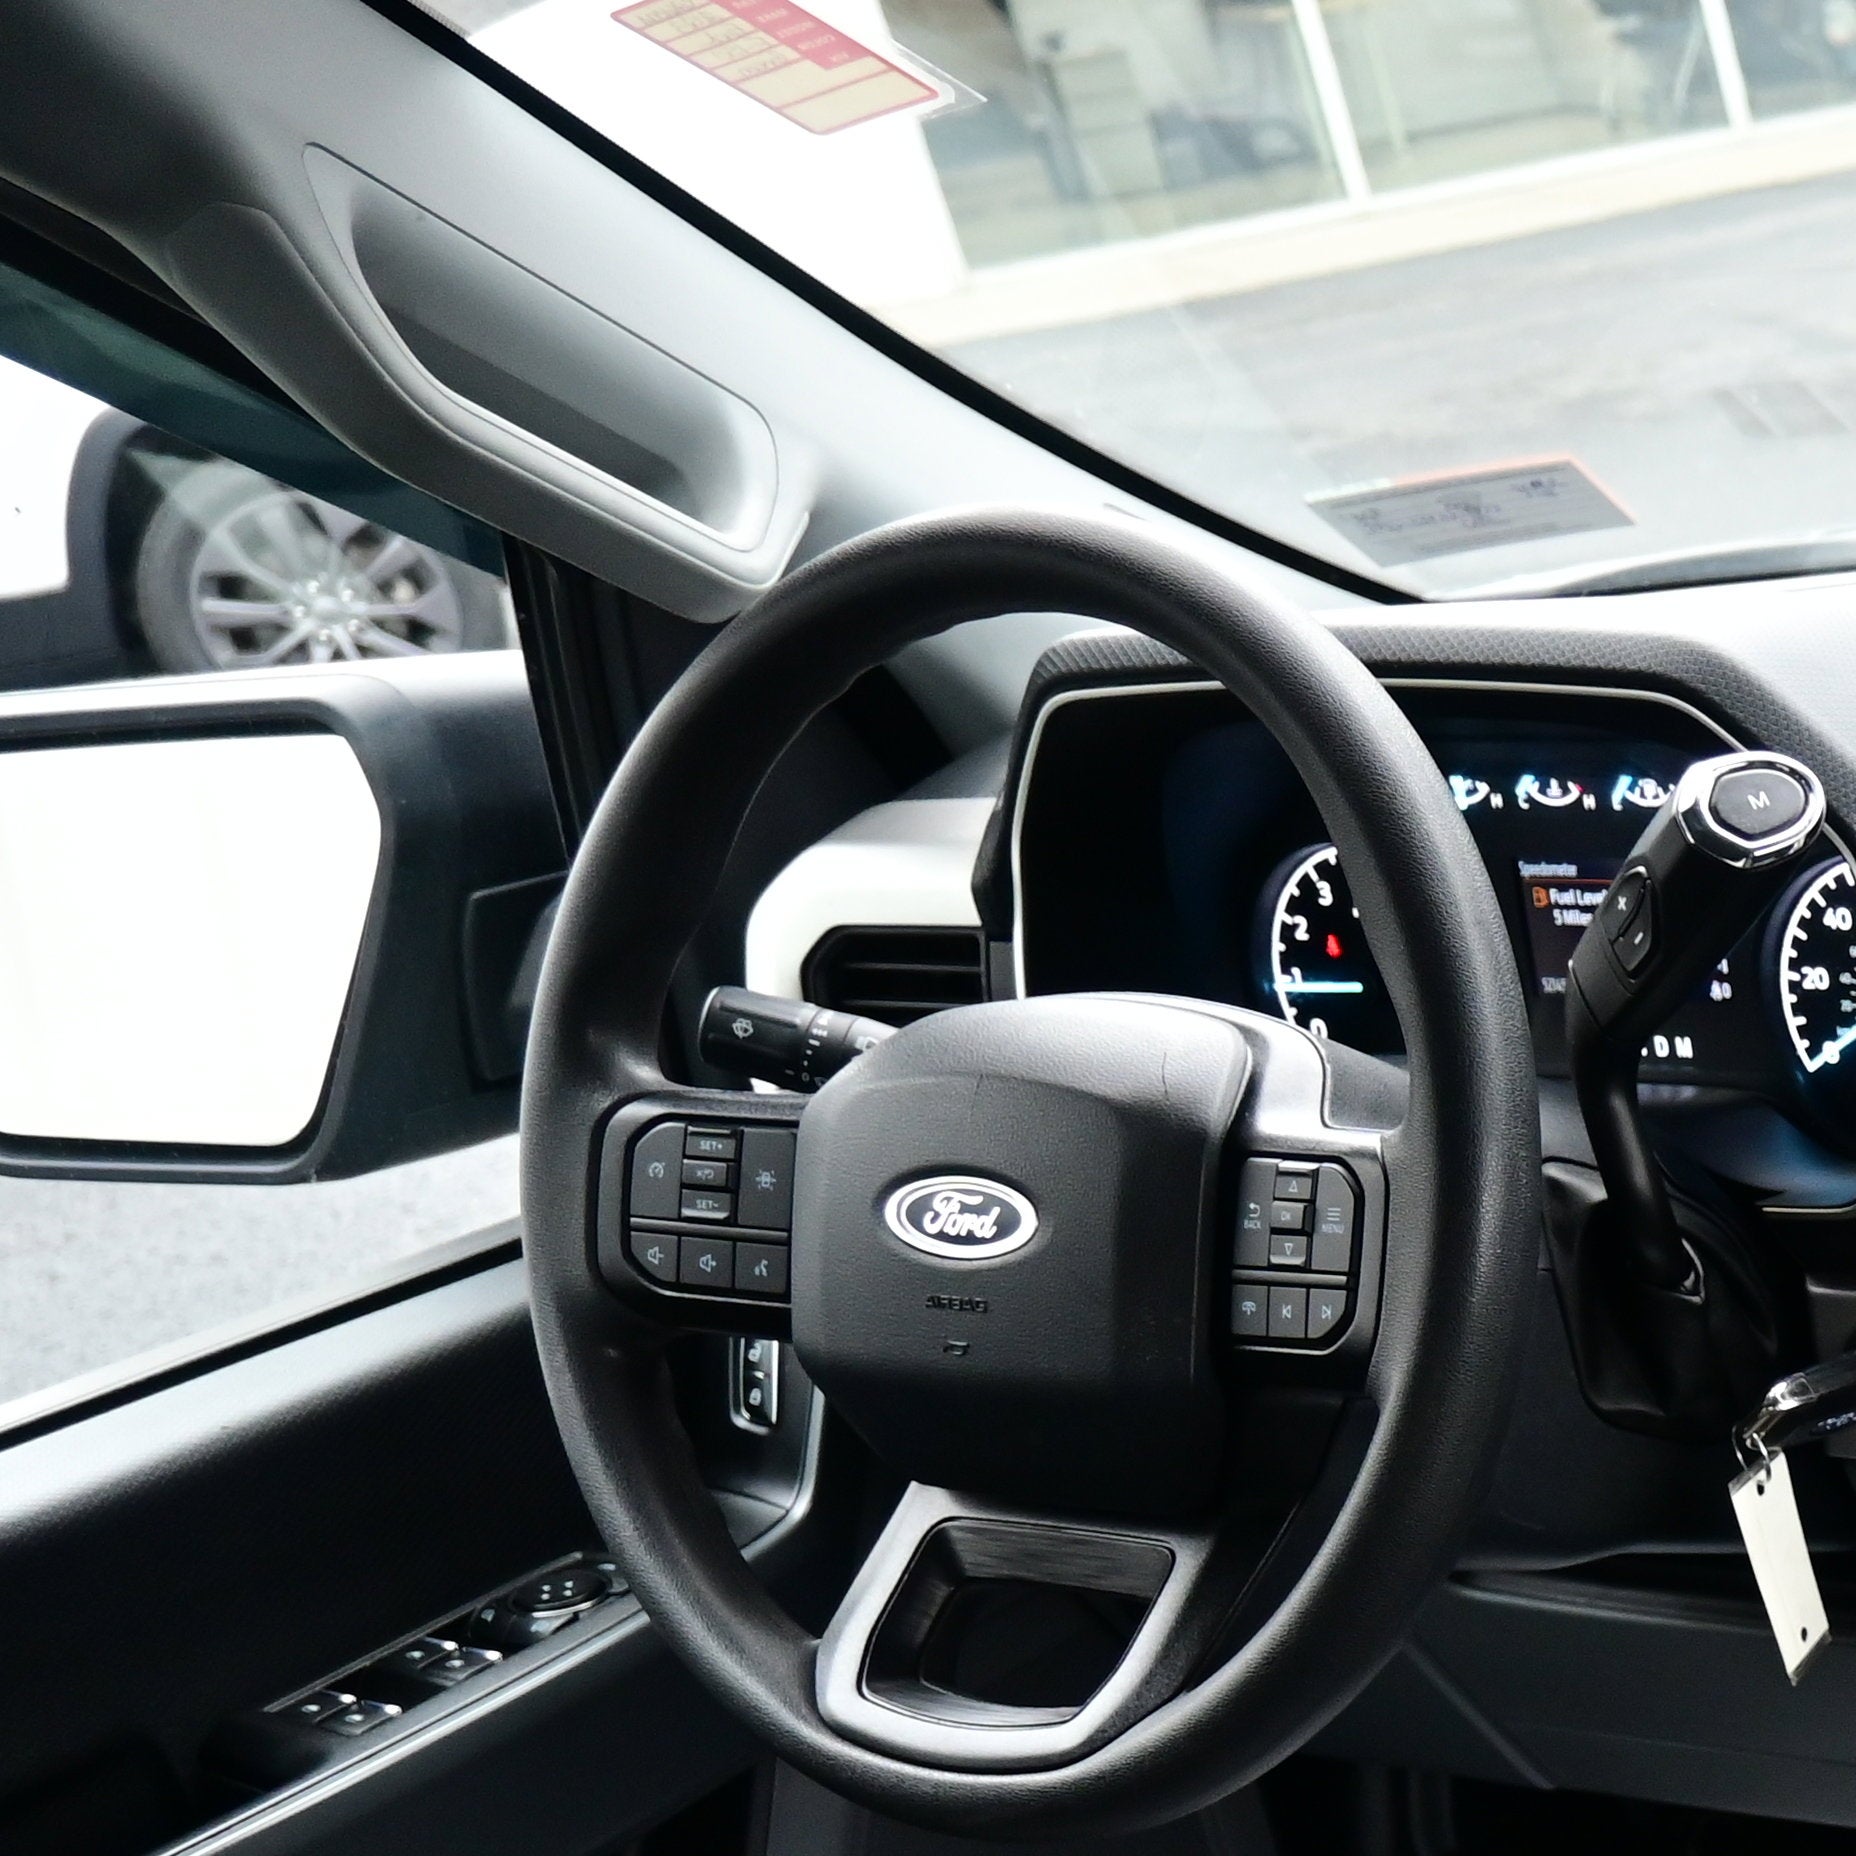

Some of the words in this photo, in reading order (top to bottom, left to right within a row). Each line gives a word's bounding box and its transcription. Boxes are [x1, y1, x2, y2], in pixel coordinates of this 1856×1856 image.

[1747, 791, 1771, 810] M
[1317, 880, 1334, 907] 3
[1549, 888, 1576, 906] Fuel
[1293, 915, 1310, 941] 2
[1822, 906, 1853, 931] 40
[1800, 966, 1830, 990] 20
[922, 1190, 998, 1240] Ford
[925, 1293, 990, 1314] AIRBAG
